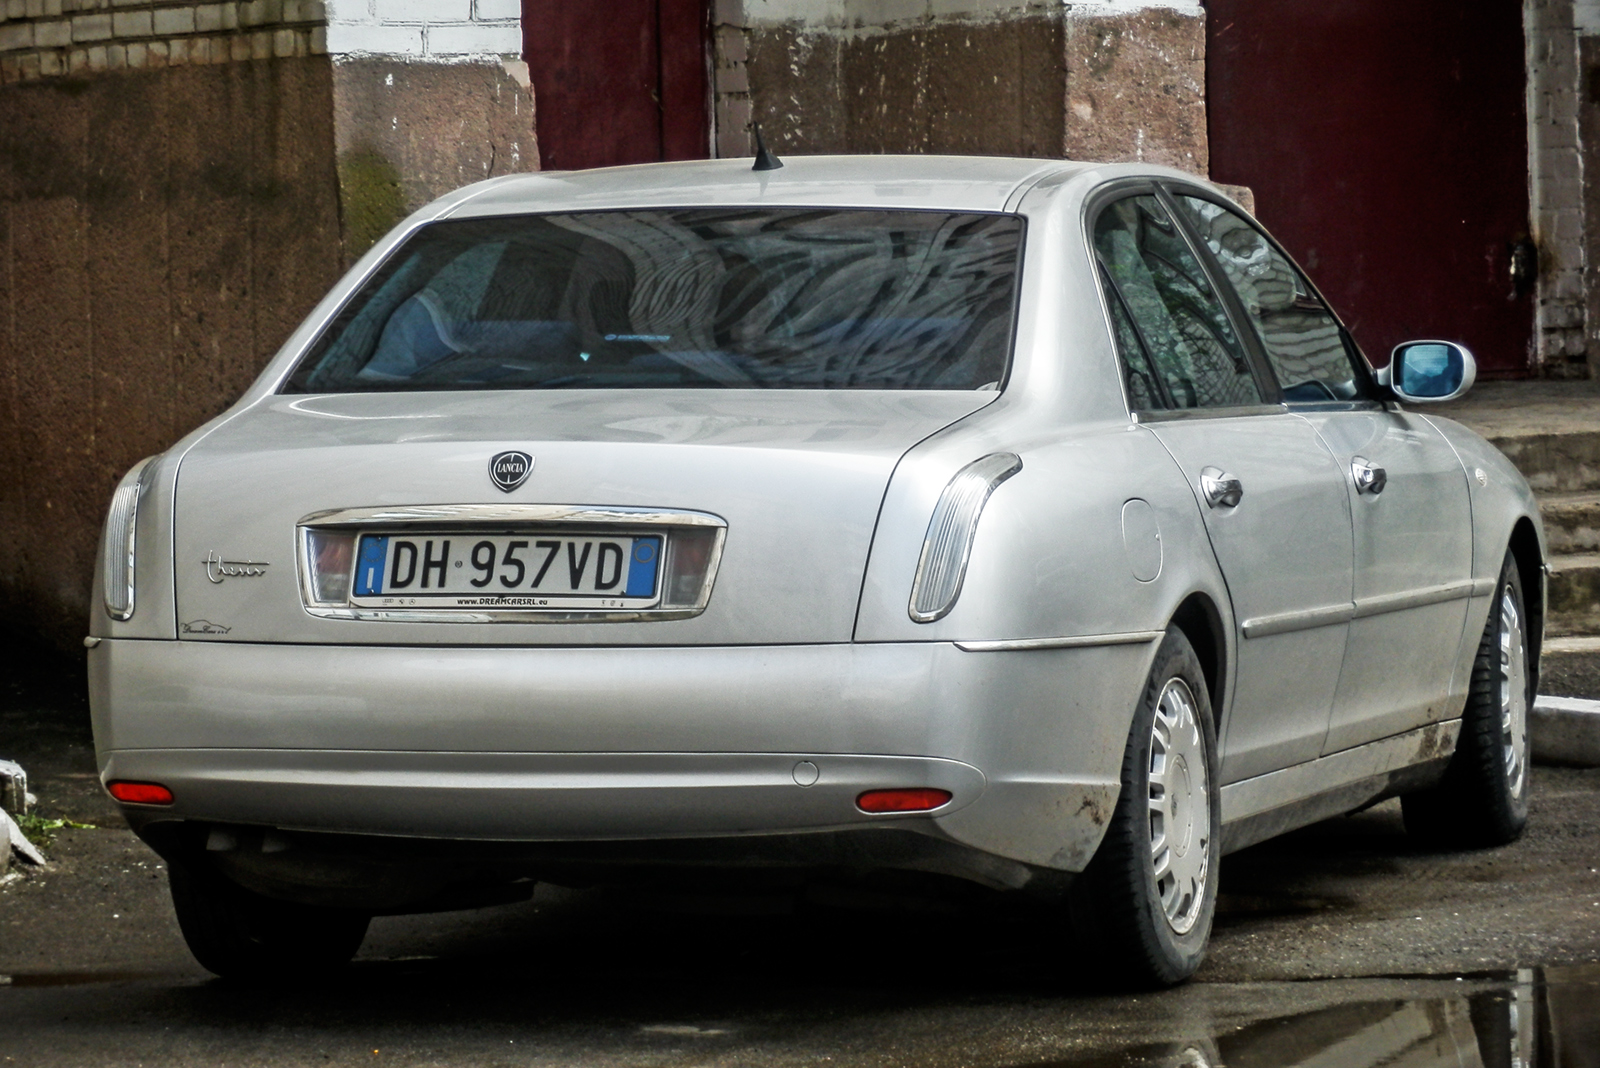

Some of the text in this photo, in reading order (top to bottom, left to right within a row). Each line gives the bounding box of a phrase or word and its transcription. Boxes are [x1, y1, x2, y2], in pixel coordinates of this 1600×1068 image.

[497, 463, 523, 473] LANCIA
[390, 540, 624, 590] DH 957VD
